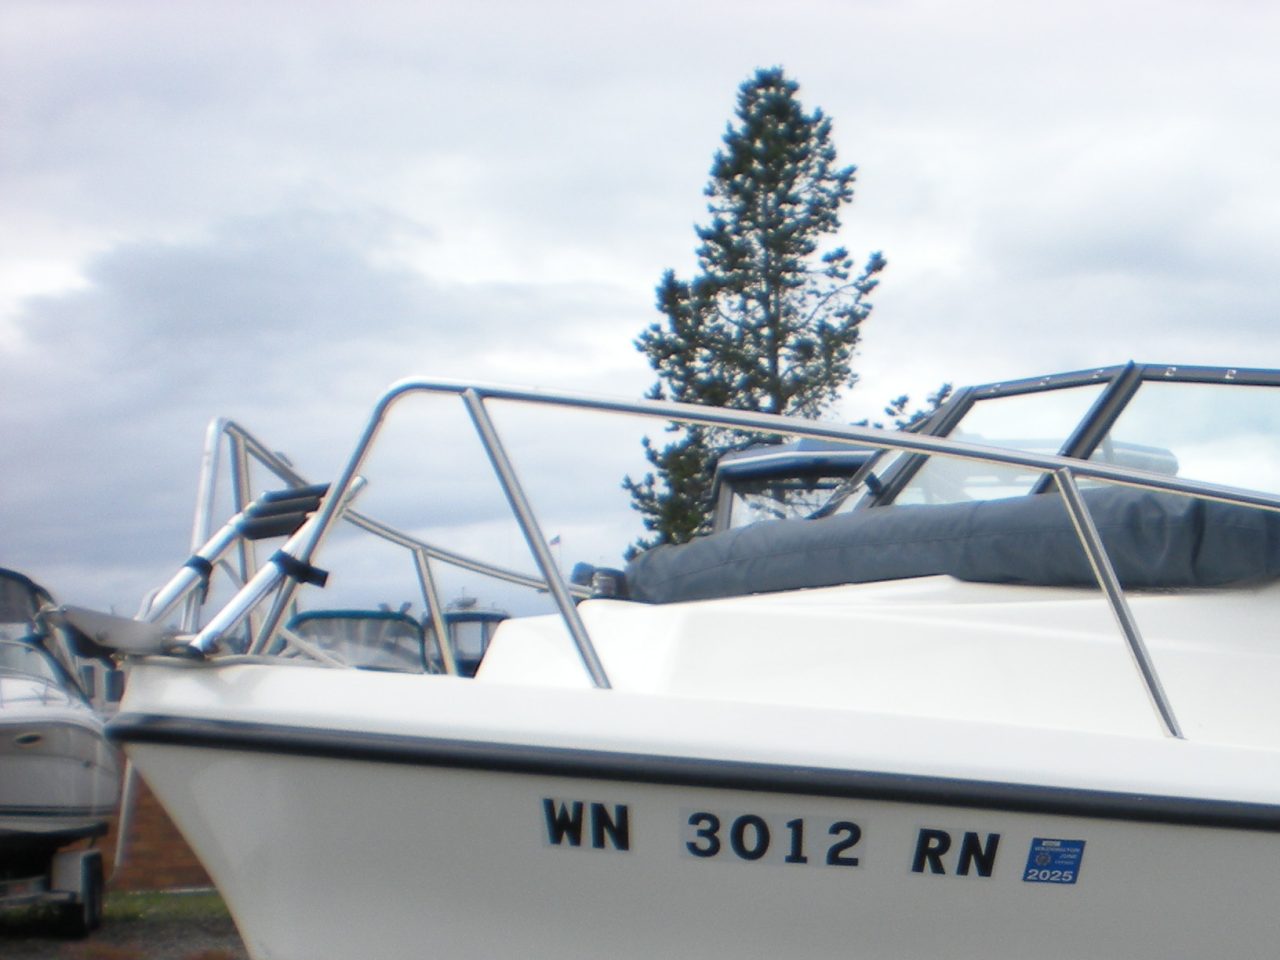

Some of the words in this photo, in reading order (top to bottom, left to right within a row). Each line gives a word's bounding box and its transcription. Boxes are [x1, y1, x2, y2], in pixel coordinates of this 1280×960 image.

[543, 798, 630, 851] WN
[686, 812, 862, 867] 3012
[911, 828, 1000, 877] RN
[1027, 869, 1074, 882] 2025
